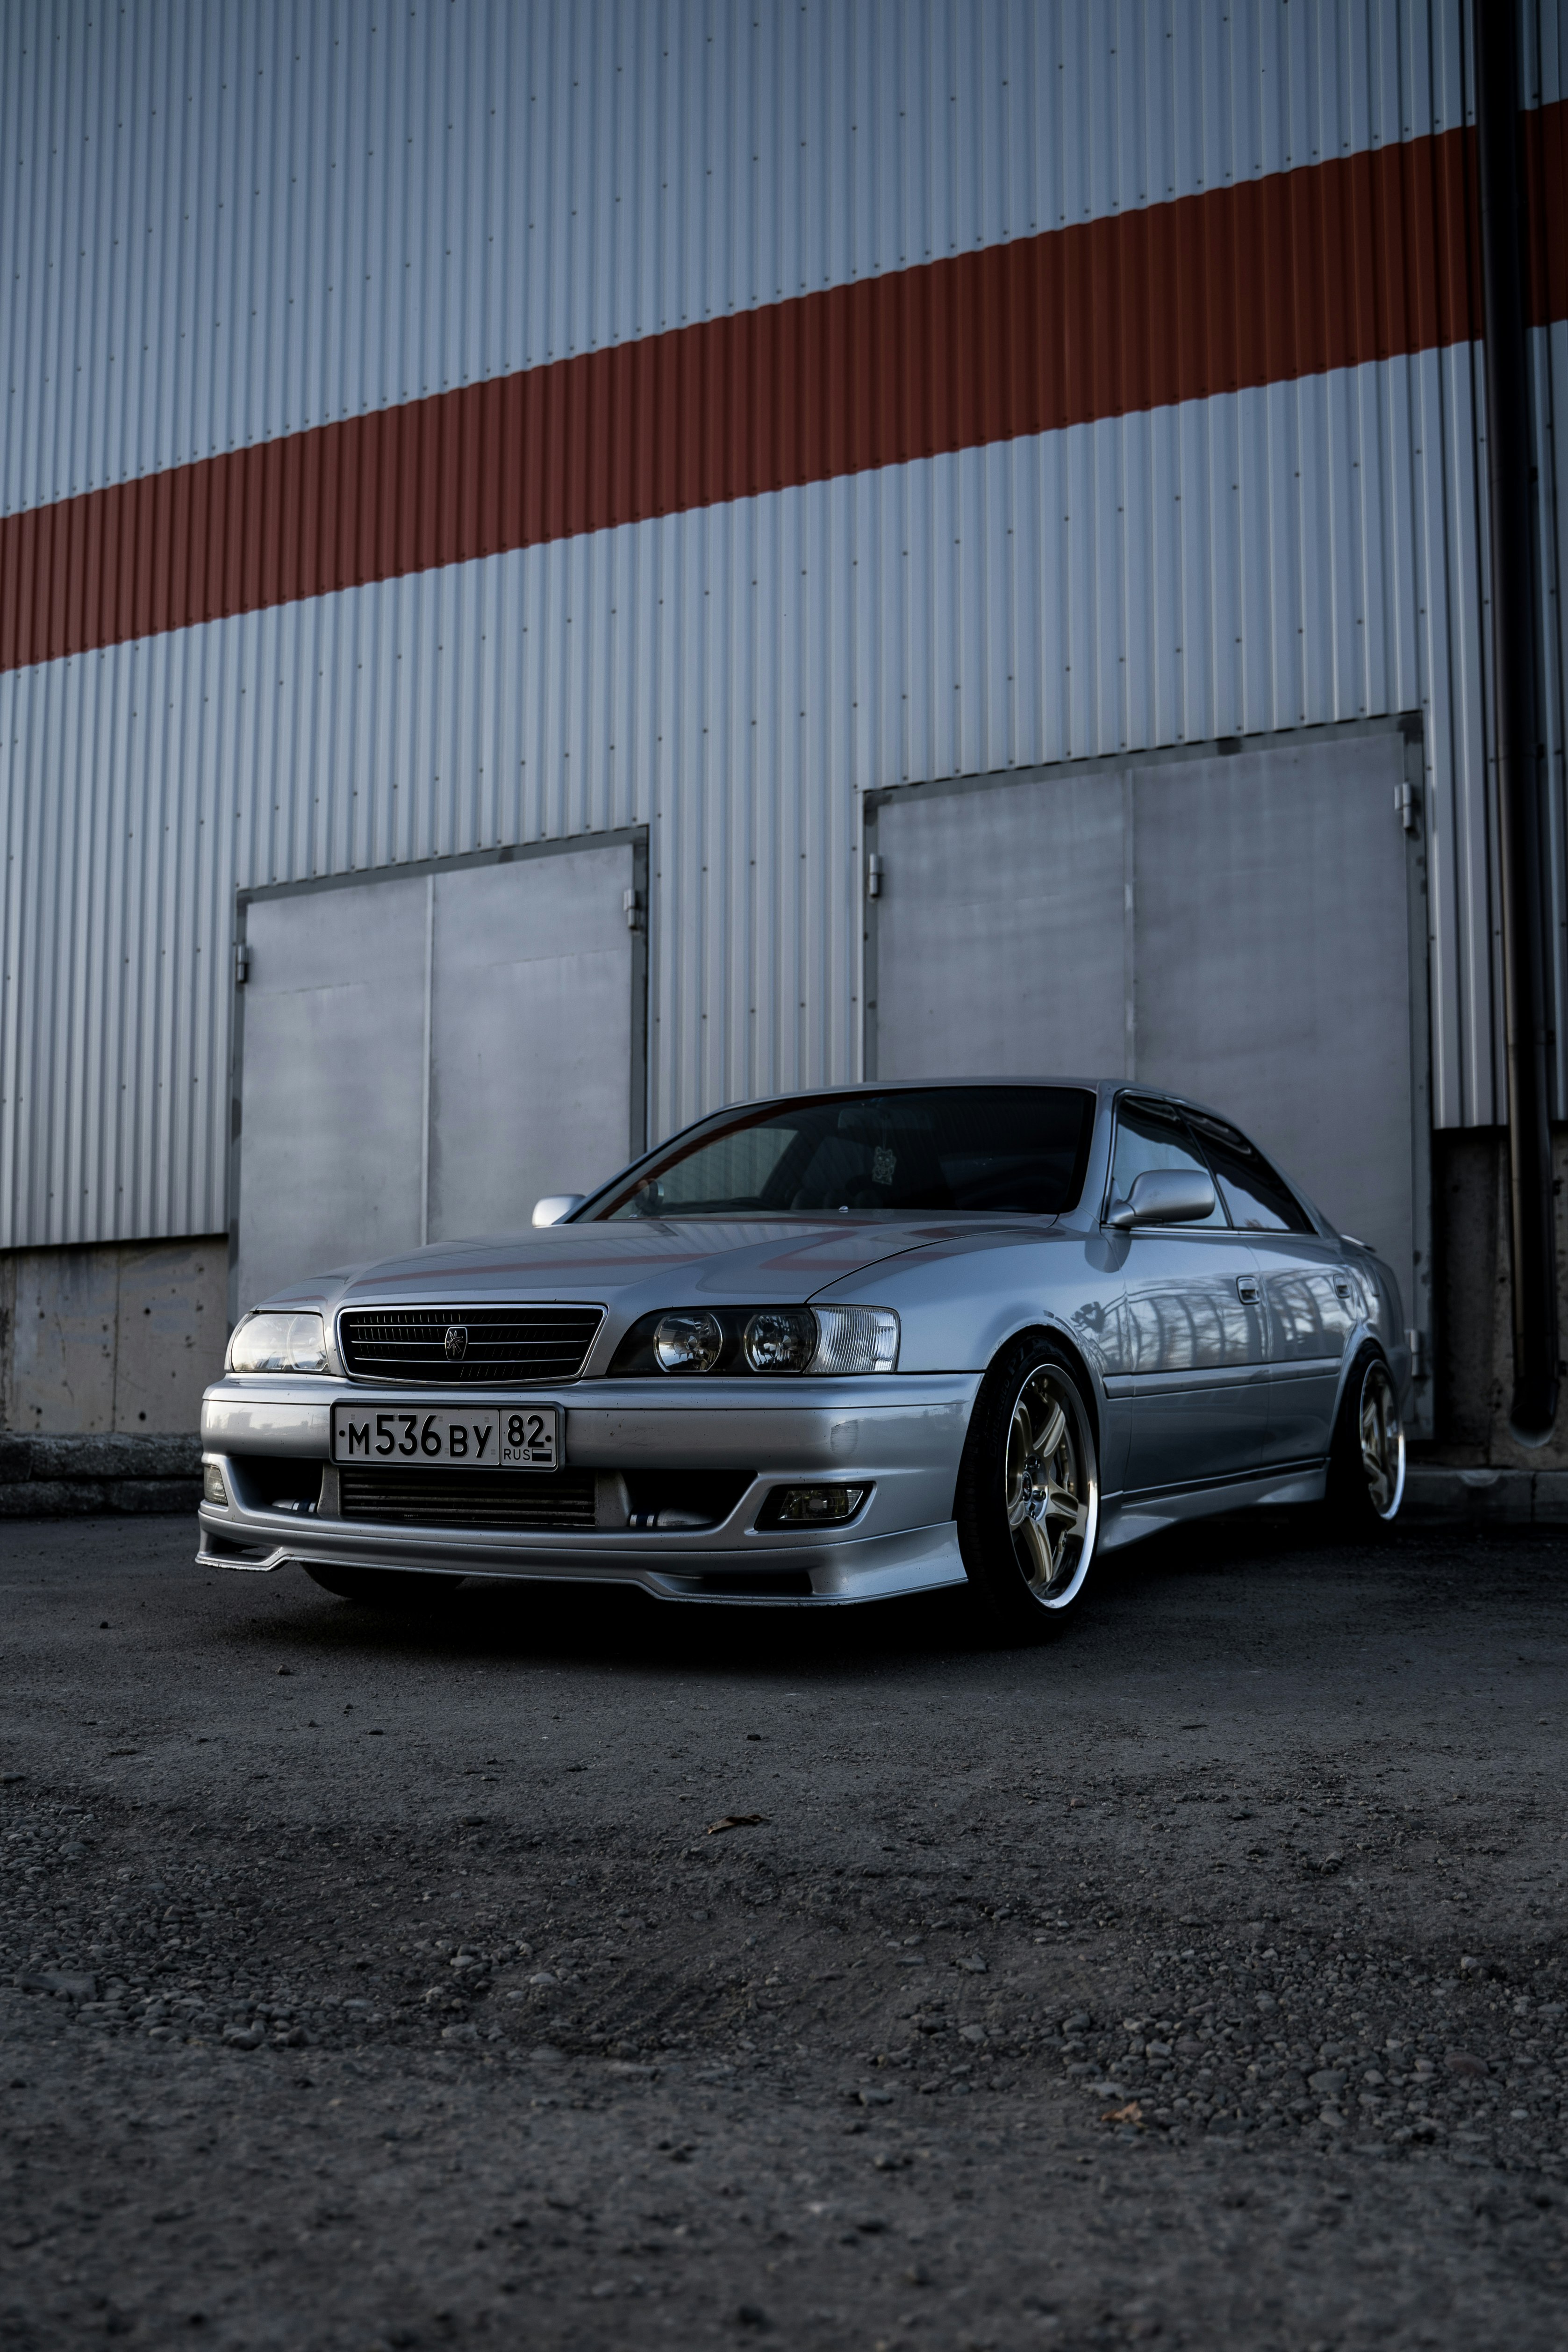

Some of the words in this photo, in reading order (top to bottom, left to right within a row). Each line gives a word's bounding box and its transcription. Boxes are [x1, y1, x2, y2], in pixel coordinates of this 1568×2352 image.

[348, 1413, 493, 1458] М536ВУ
[507, 1413, 544, 1448] 82
[989, 1378, 1010, 1457] Cinturato
[503, 1448, 530, 1460] RUS
